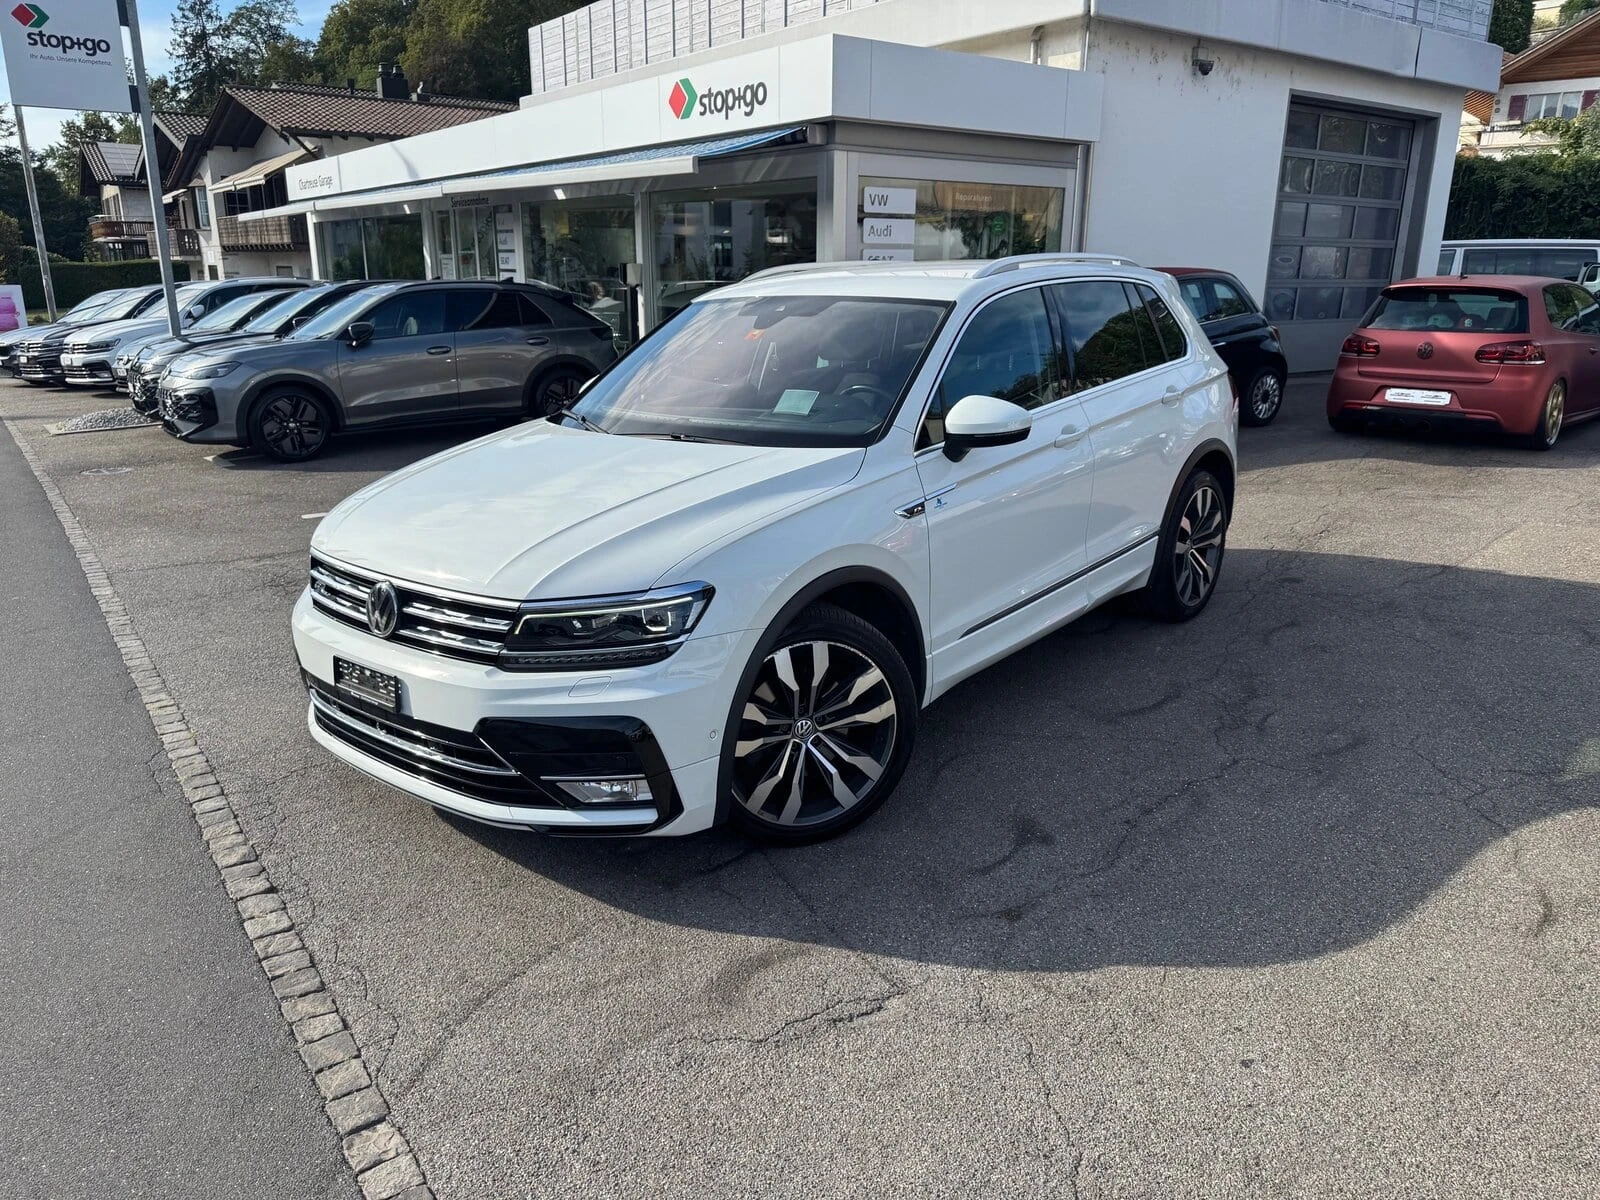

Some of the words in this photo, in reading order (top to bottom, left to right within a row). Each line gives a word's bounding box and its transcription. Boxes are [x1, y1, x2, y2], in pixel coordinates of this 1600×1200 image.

[27, 30, 111, 57] stop+go
[699, 82, 768, 121] stop+go
[869, 193, 889, 207] VW
[868, 224, 893, 238] Audi
